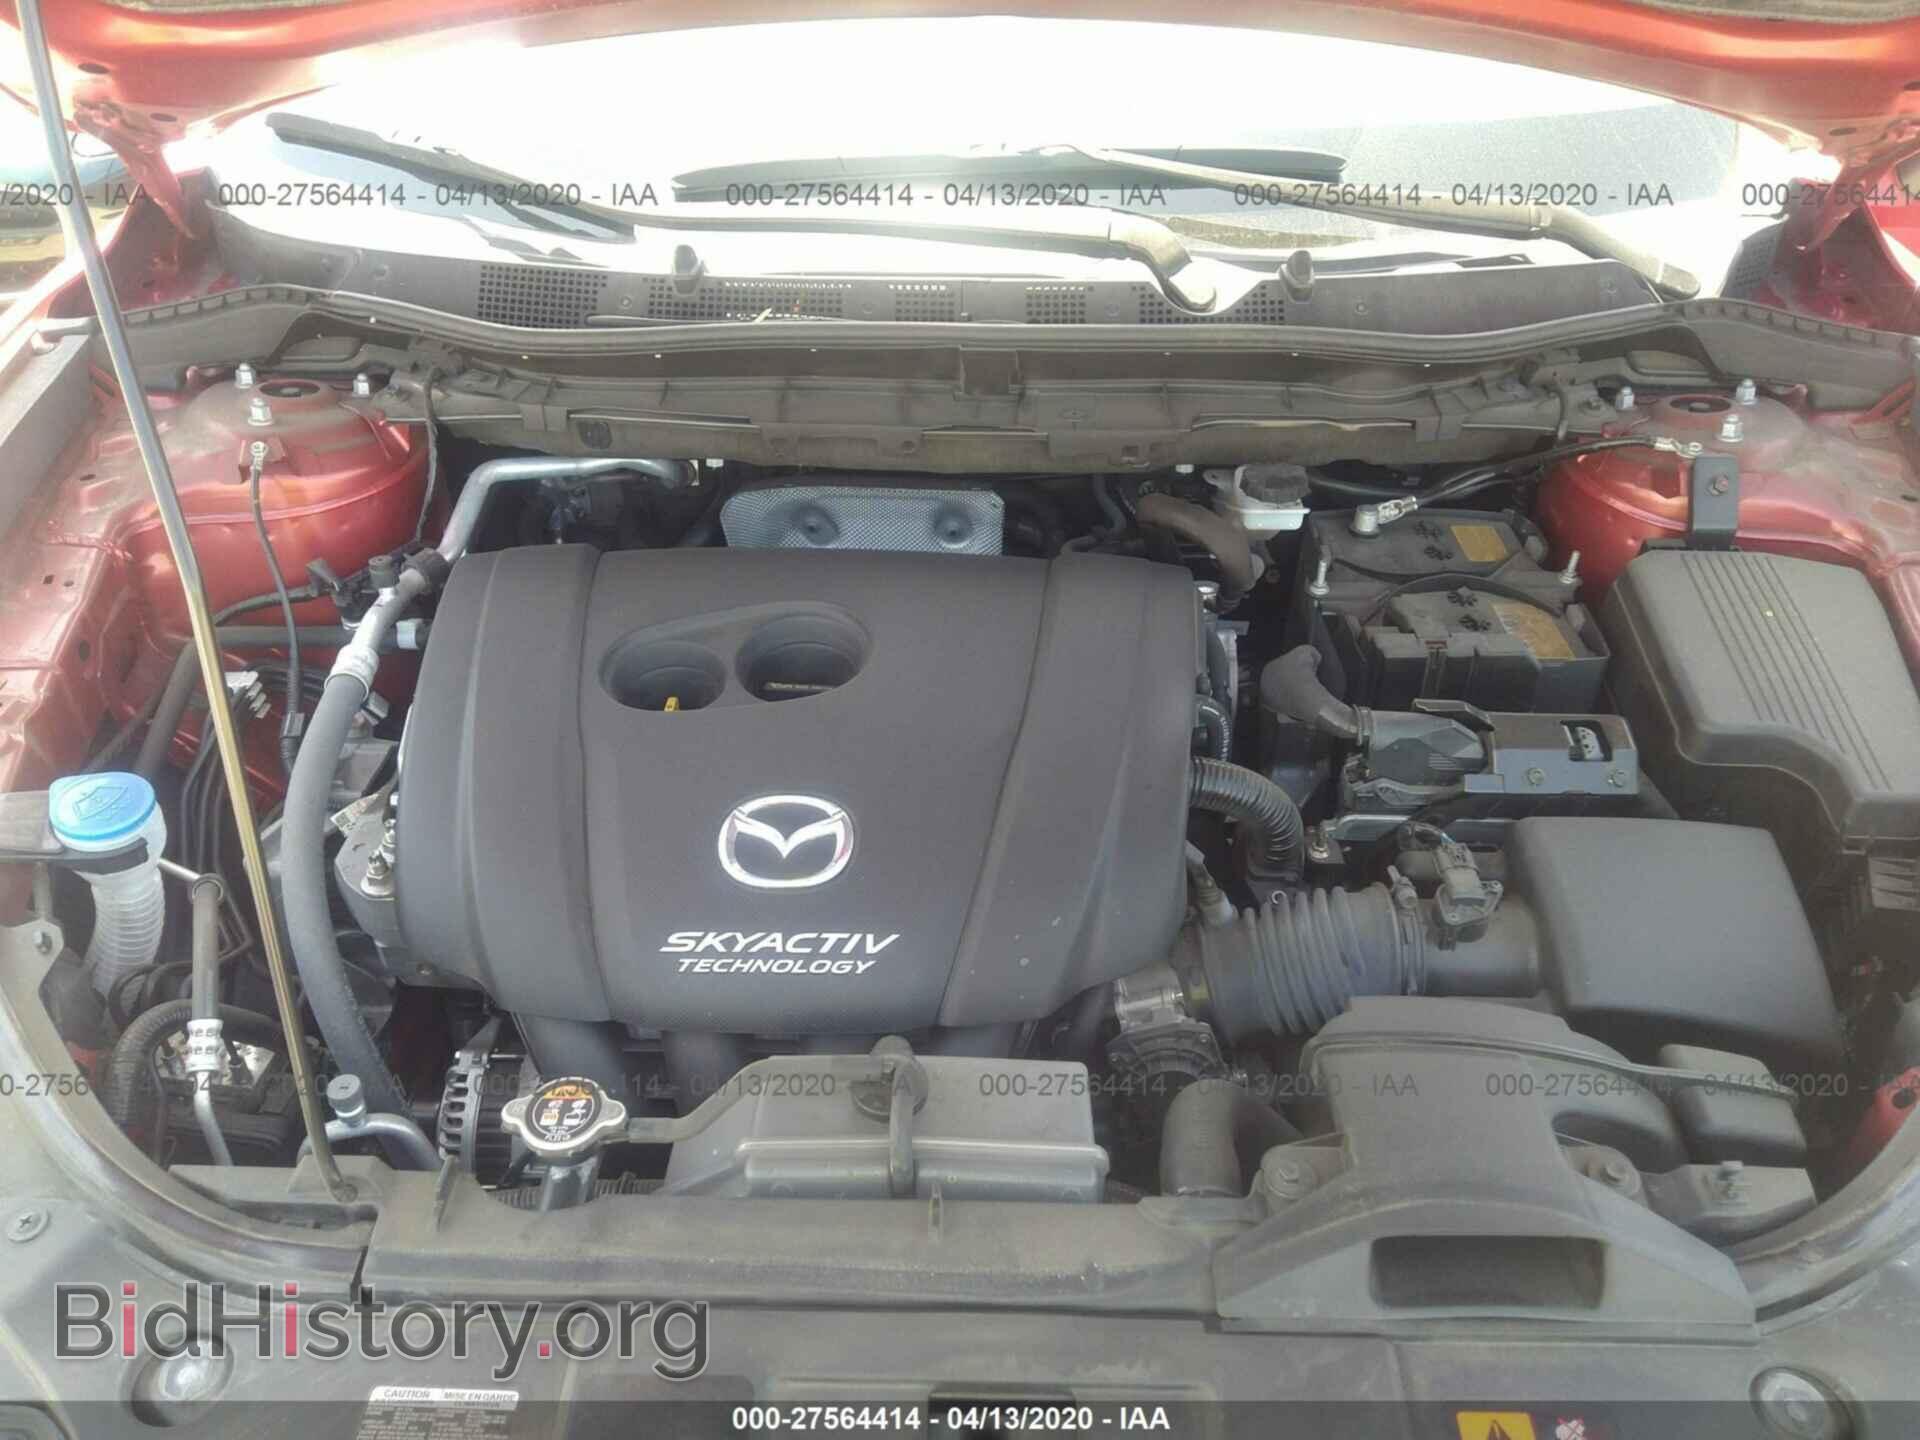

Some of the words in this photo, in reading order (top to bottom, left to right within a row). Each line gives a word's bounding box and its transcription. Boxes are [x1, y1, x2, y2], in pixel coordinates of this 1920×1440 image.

[658, 931, 900, 954] SKYACTIV
[677, 958, 876, 975] TECHNOLOGY
[383, 1388, 432, 1399] CAUTION
[444, 1391, 466, 1400] MISE
[468, 1392, 482, 1401] EN
